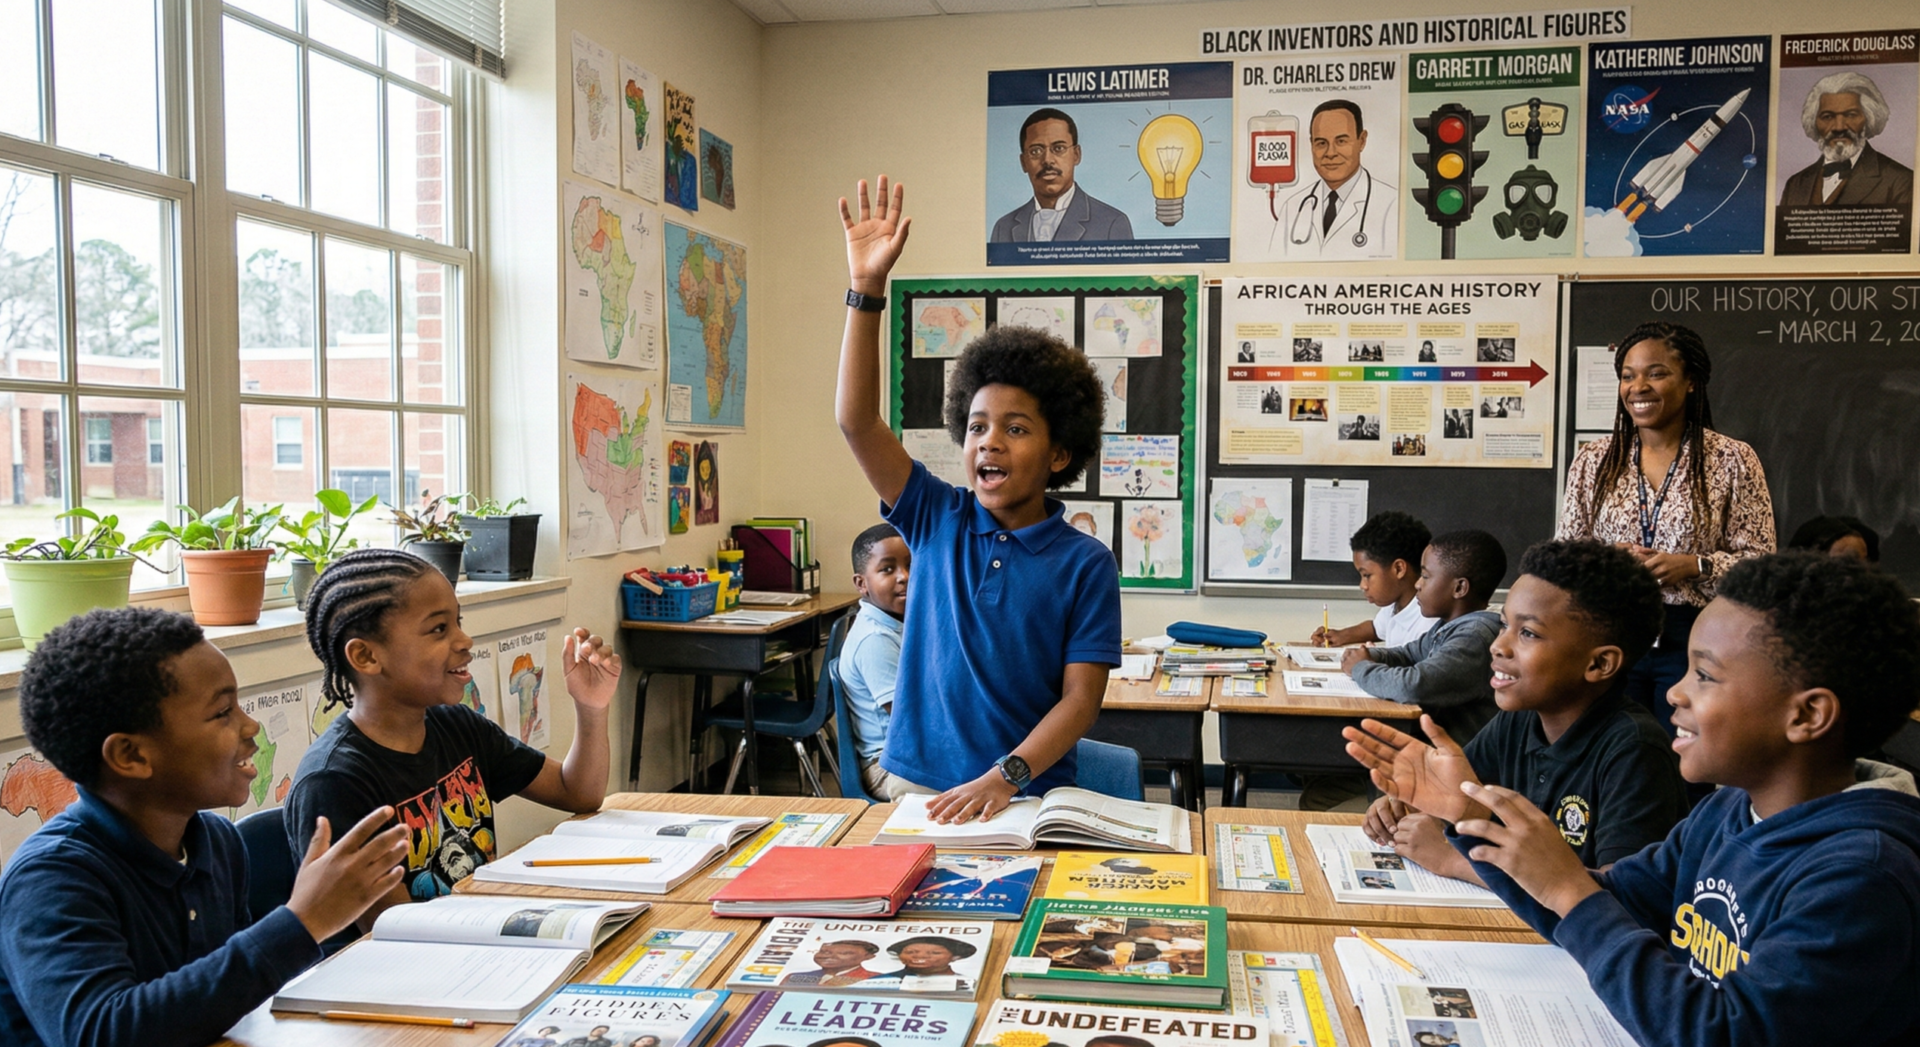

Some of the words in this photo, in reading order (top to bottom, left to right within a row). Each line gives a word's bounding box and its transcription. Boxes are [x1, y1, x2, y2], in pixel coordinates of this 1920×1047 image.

[1203, 29, 1262, 54] BLACK
[1268, 24, 1373, 51] INVENTORS
[1378, 22, 1418, 46] AND
[1424, 15, 1538, 43] HISTORICAL
[1543, 10, 1627, 38] FIGURES
[1785, 37, 1850, 55] FREDERICK
[1853, 34, 1916, 52] DOUGLASS
[1595, 46, 1685, 69] KATHERINE
[1688, 43, 1764, 66] JOHNSON
[1243, 67, 1268, 86] DR.
[1273, 63, 1345, 85] CHARLES
[1349, 61, 1396, 82] DREW
[1416, 57, 1493, 80] GARRETT
[1498, 53, 1573, 76] MORGAN
[1048, 71, 1096, 93] LEWIS
[1100, 68, 1169, 91] LATIMER
[1605, 103, 1650, 116] NASA
[1508, 121, 1525, 129] GAS
[1257, 151, 1289, 161] PLASMA
[1259, 142, 1287, 152] BLOOD
[1237, 284, 1327, 299] AFRICAN
[1334, 283, 1443, 299] AMERICAN
[1451, 282, 1542, 298] HISTORY
[1305, 303, 1385, 315] THROUGH
[1390, 303, 1422, 315] THE
[1427, 302, 1471, 315] AGES
[1651, 286, 1701, 312] OUR
[1714, 285, 1820, 317] HISTORY,
[1830, 286, 1878, 311] OUR
[1779, 320, 1856, 343] MARCH
[1869, 320, 1891, 346] 2,
[782, 920, 816, 930] THE
[547, 1007, 692, 1021] FIGURES
[571, 998, 688, 1011] HIDDEN
[812, 999, 931, 1018] LITTLE
[779, 1011, 949, 1034] LEADERS
[1021, 1009, 1258, 1041] UNDEFEATED
